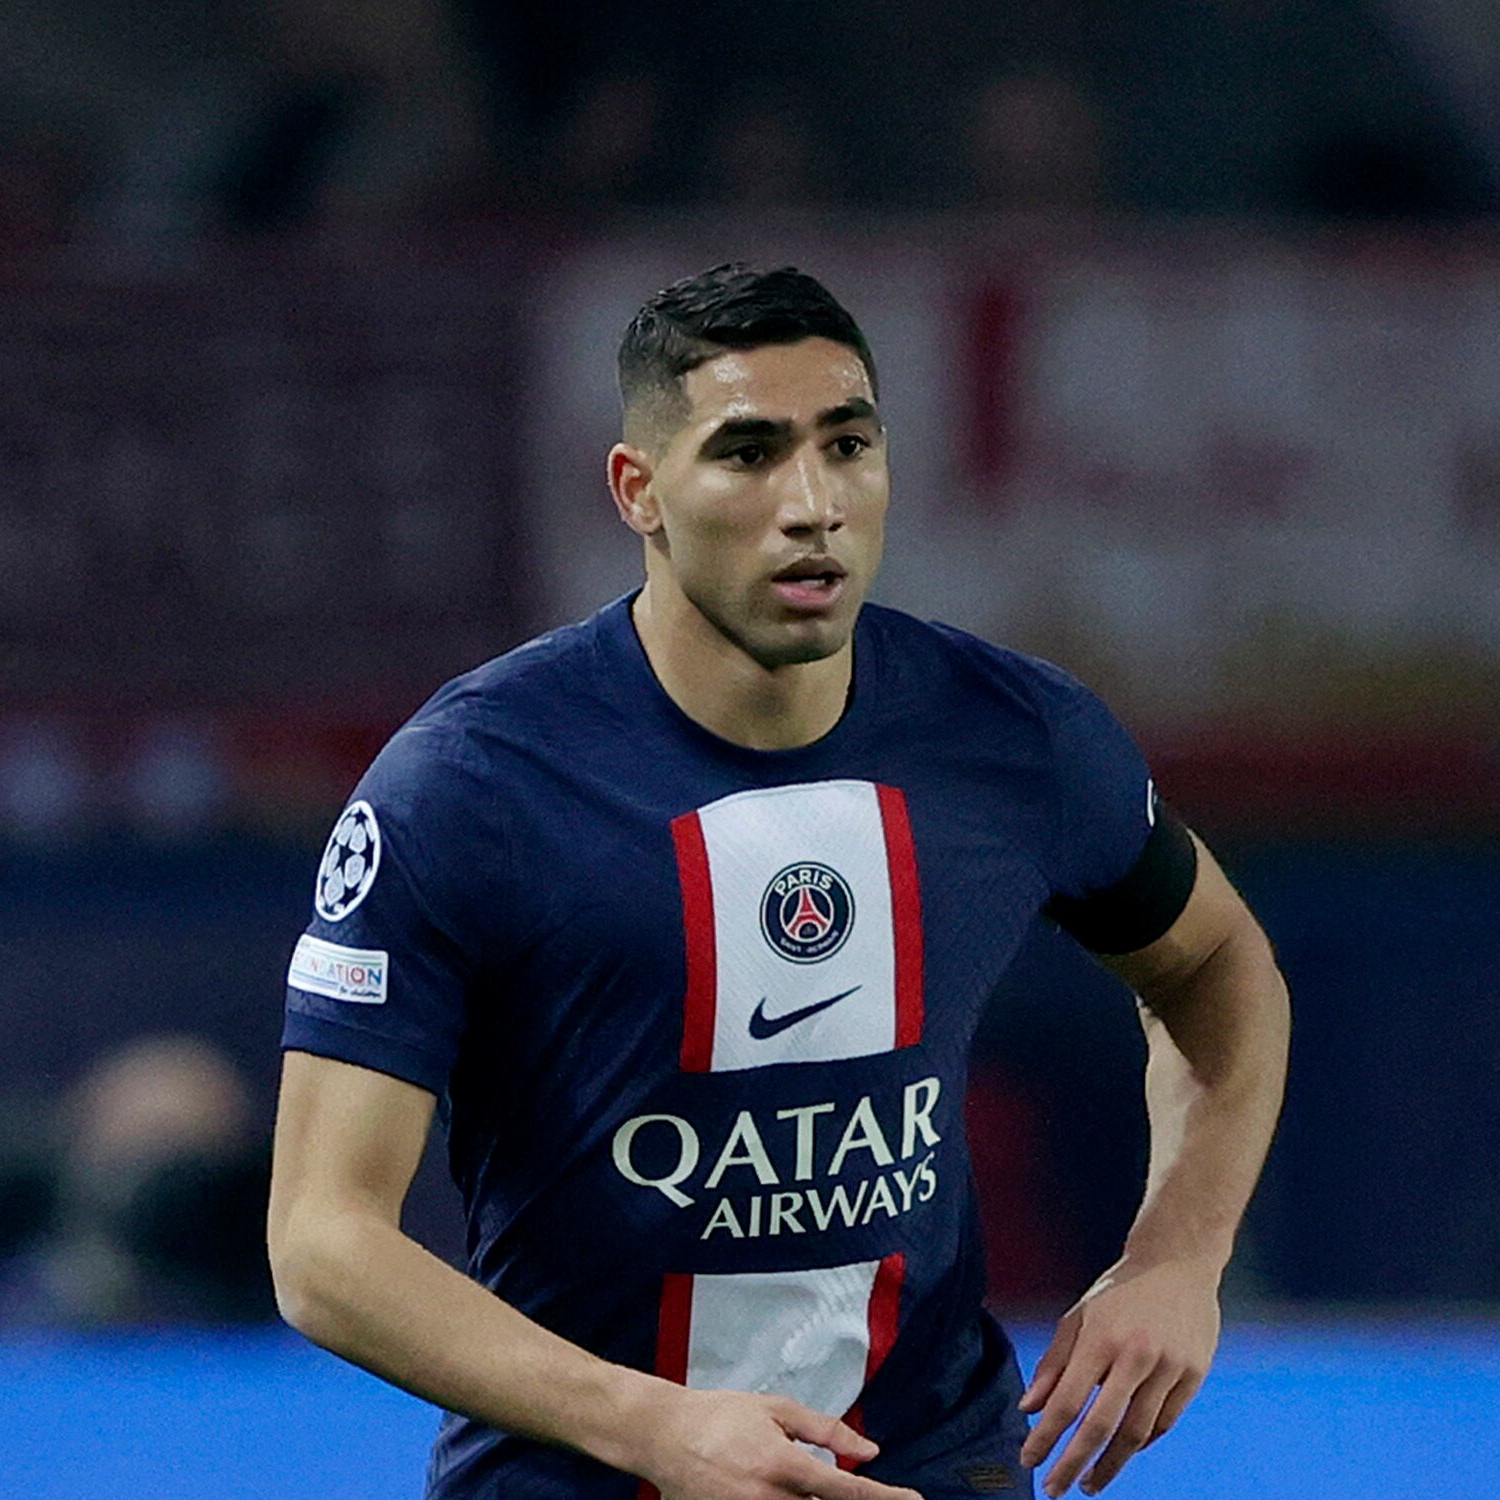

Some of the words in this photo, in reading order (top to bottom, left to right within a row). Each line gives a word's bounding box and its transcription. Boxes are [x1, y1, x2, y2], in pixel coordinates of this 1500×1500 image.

[774, 869, 834, 897] PARIS
[611, 1076, 942, 1209] QATAR
[700, 1150, 937, 1241] AIRWAYS
